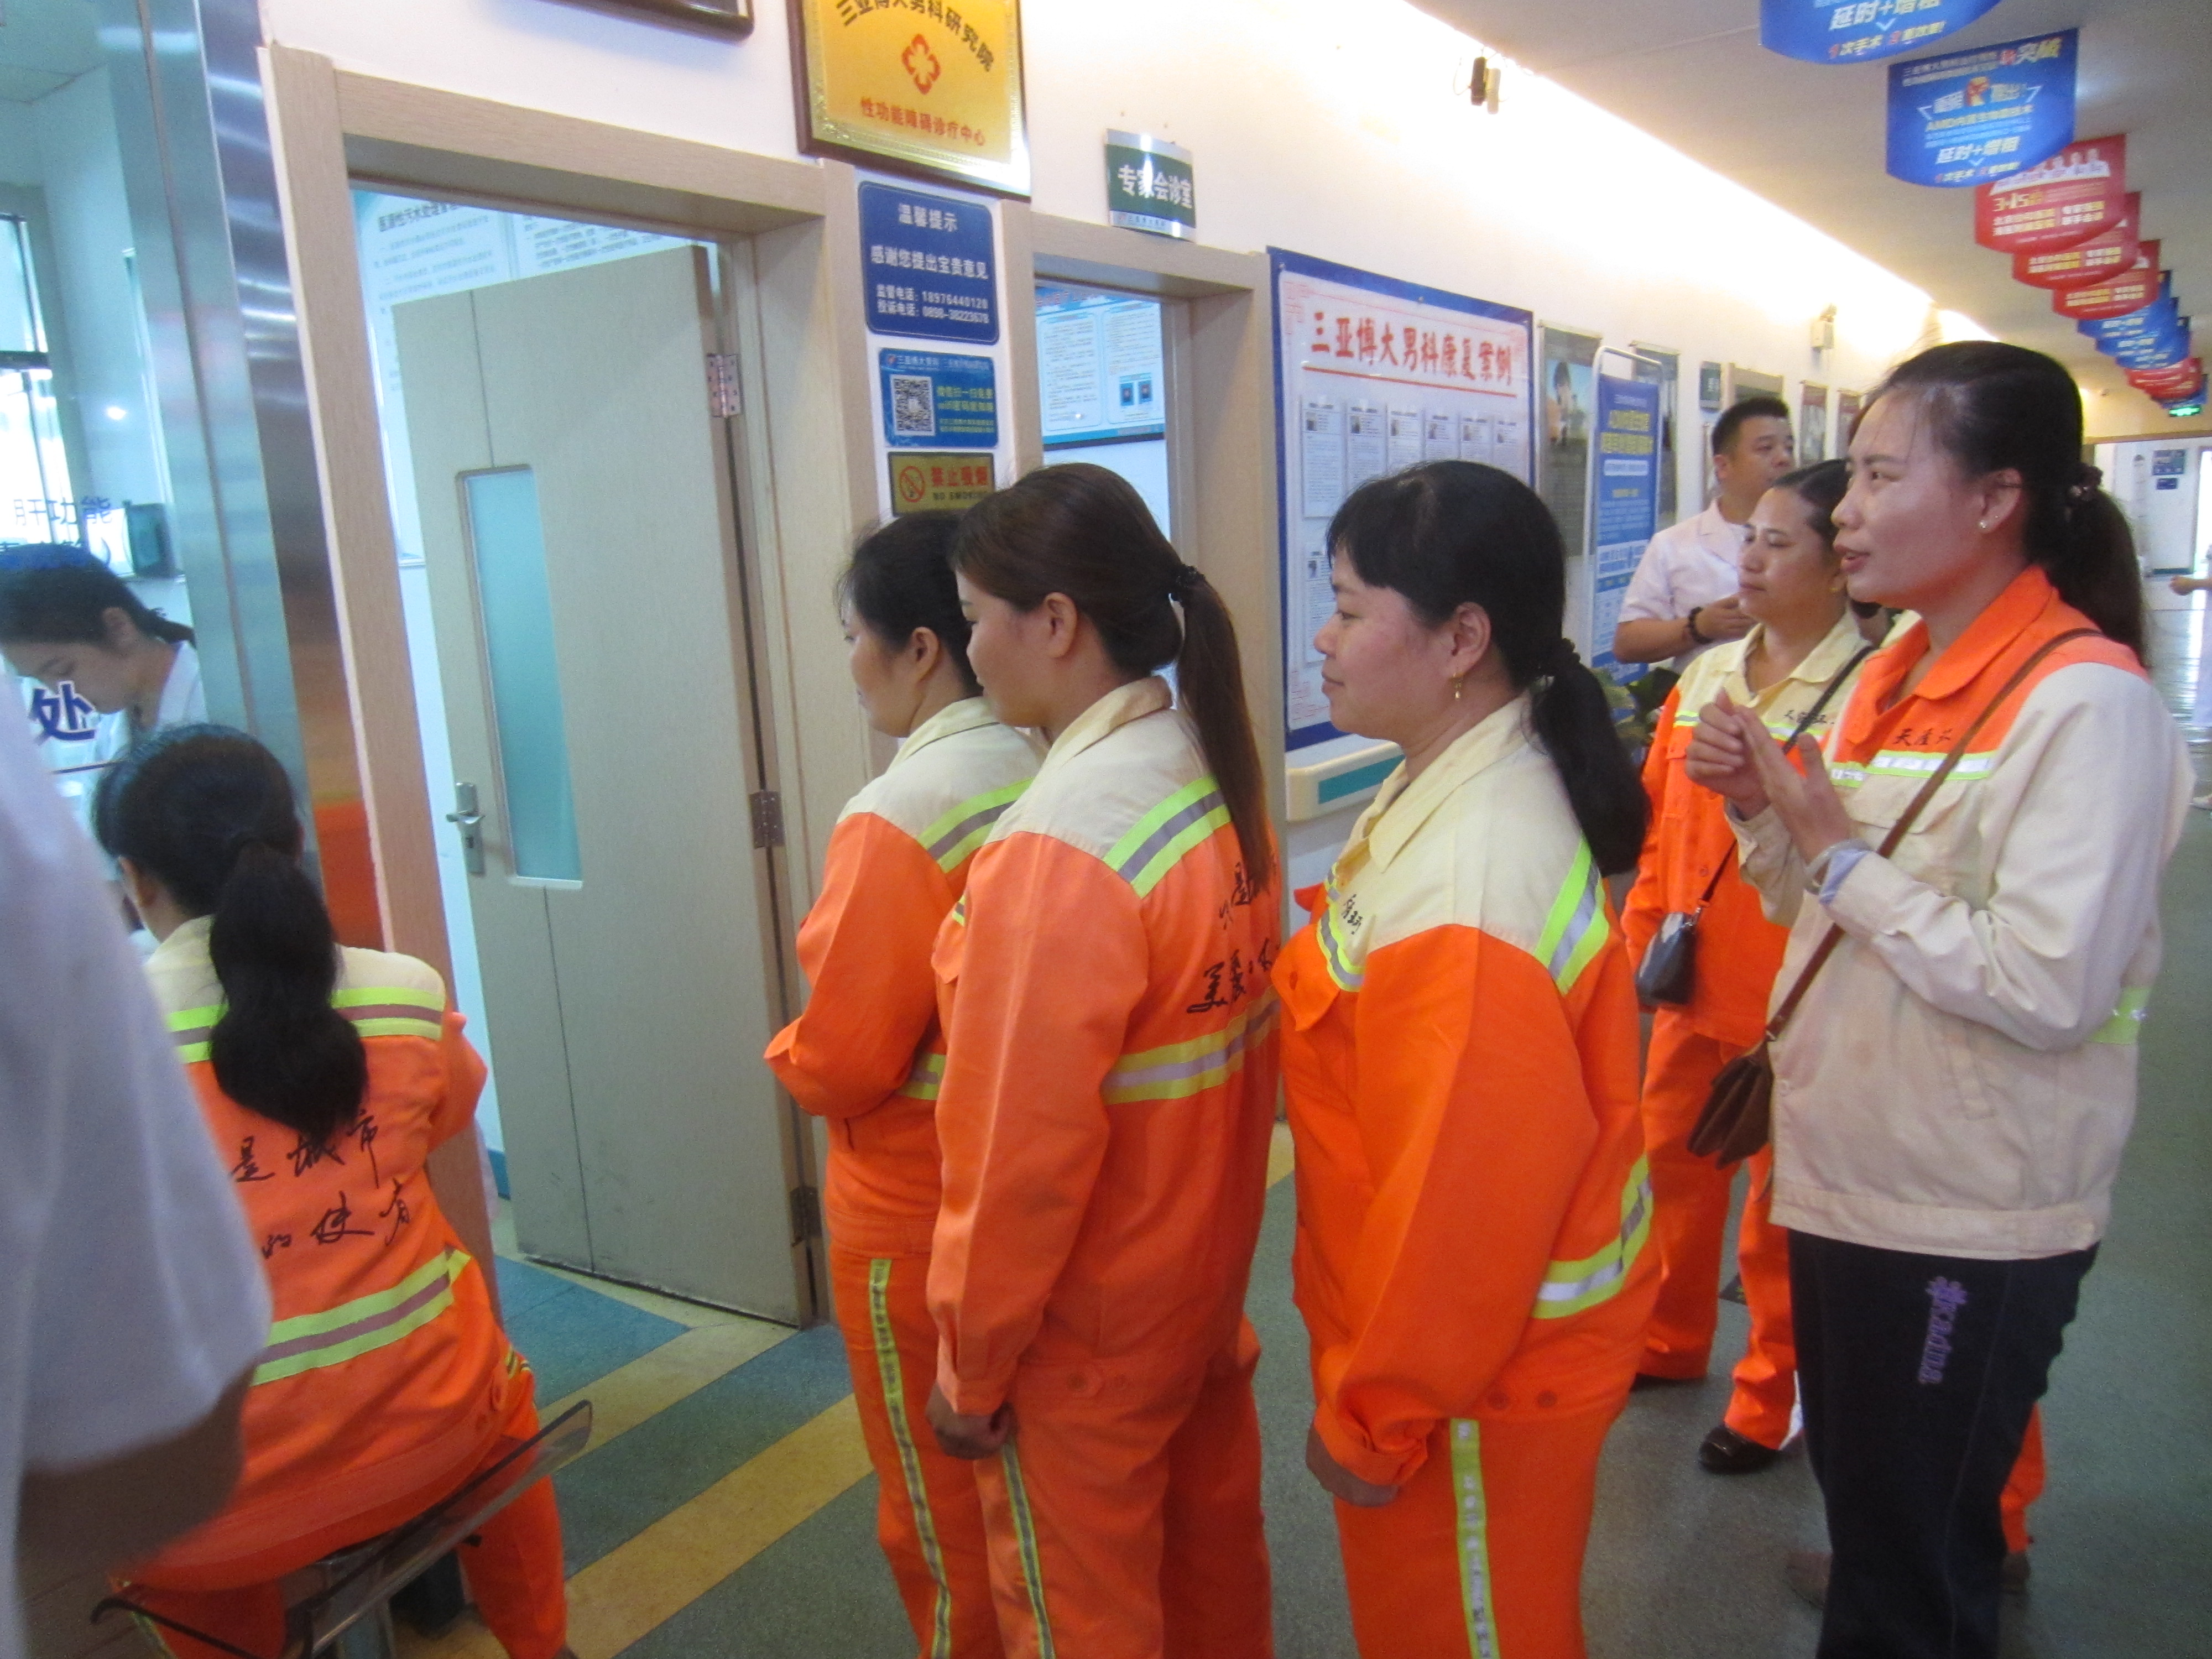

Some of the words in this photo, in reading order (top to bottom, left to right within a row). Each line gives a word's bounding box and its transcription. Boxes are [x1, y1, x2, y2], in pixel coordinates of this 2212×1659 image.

[898, 204, 958, 232] 温馨提示
[870, 245, 989, 280] 感谢您提出宝贵意见
[1311, 311, 1512, 387] 三亚博大男科康复案例
[13, 495, 112, 526] 肝功能
